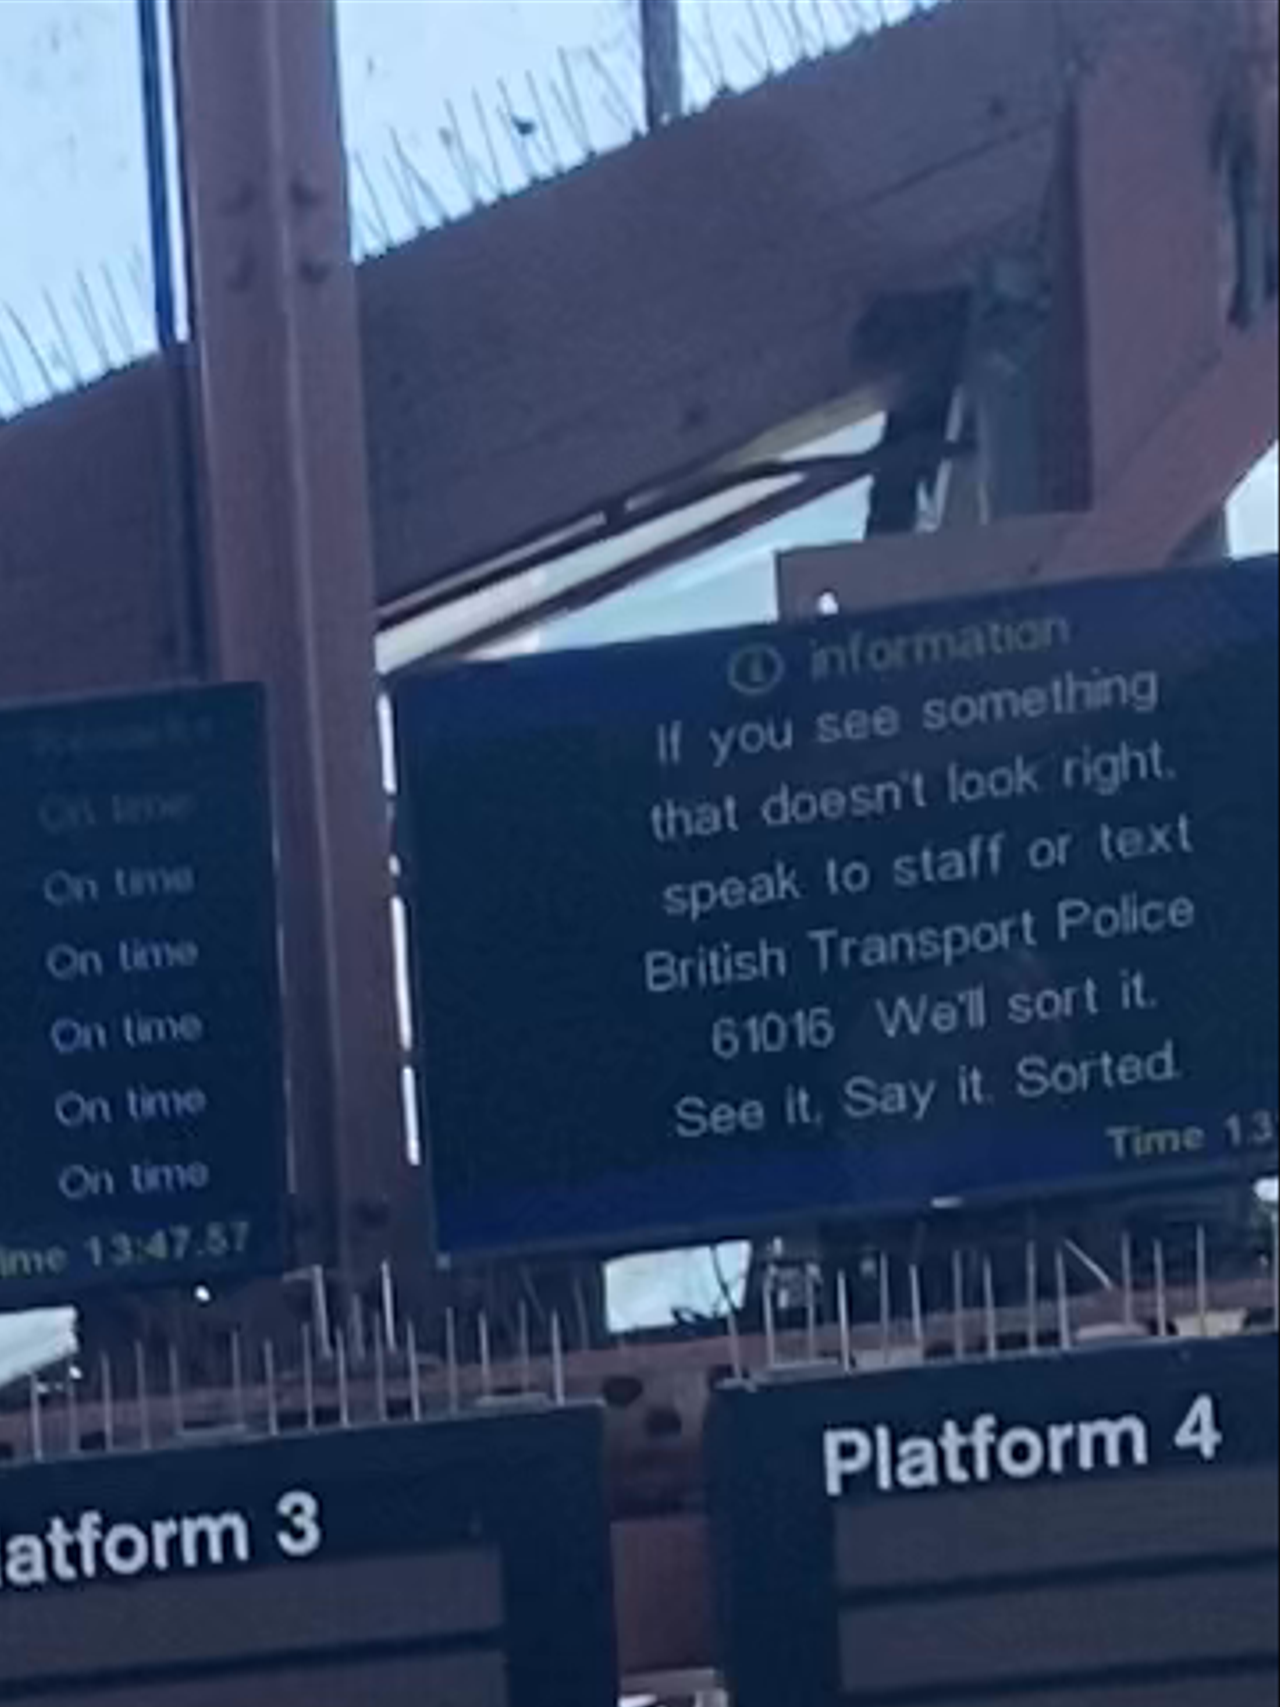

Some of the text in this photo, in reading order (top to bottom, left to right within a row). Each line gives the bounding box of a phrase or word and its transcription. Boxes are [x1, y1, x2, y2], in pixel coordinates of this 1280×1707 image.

[809, 610, 1071, 683] information
[656, 668, 1159, 768] If you see something
[649, 795, 740, 843] that
[760, 769, 927, 829] doesn't
[946, 755, 1040, 804] look
[43, 868, 99, 907] On
[115, 865, 195, 896] time
[660, 810, 1196, 922] speak to staff or text
[45, 941, 104, 982] On
[119, 937, 200, 974] time
[643, 894, 1196, 994] British Transport Police
[49, 1015, 108, 1055] On
[122, 1010, 204, 1048] time
[709, 968, 1159, 1060] 61016 We'll sort it.
[54, 1089, 113, 1129] On
[126, 1084, 209, 1123] time
[671, 1094, 766, 1139] See
[841, 1075, 937, 1123] Say
[1105, 1124, 1206, 1160] Time
[57, 1164, 115, 1200] On
[129, 1159, 211, 1195] time
[822, 1395, 1222, 1496] Platform 4
[276, 1490, 323, 1556] 3
